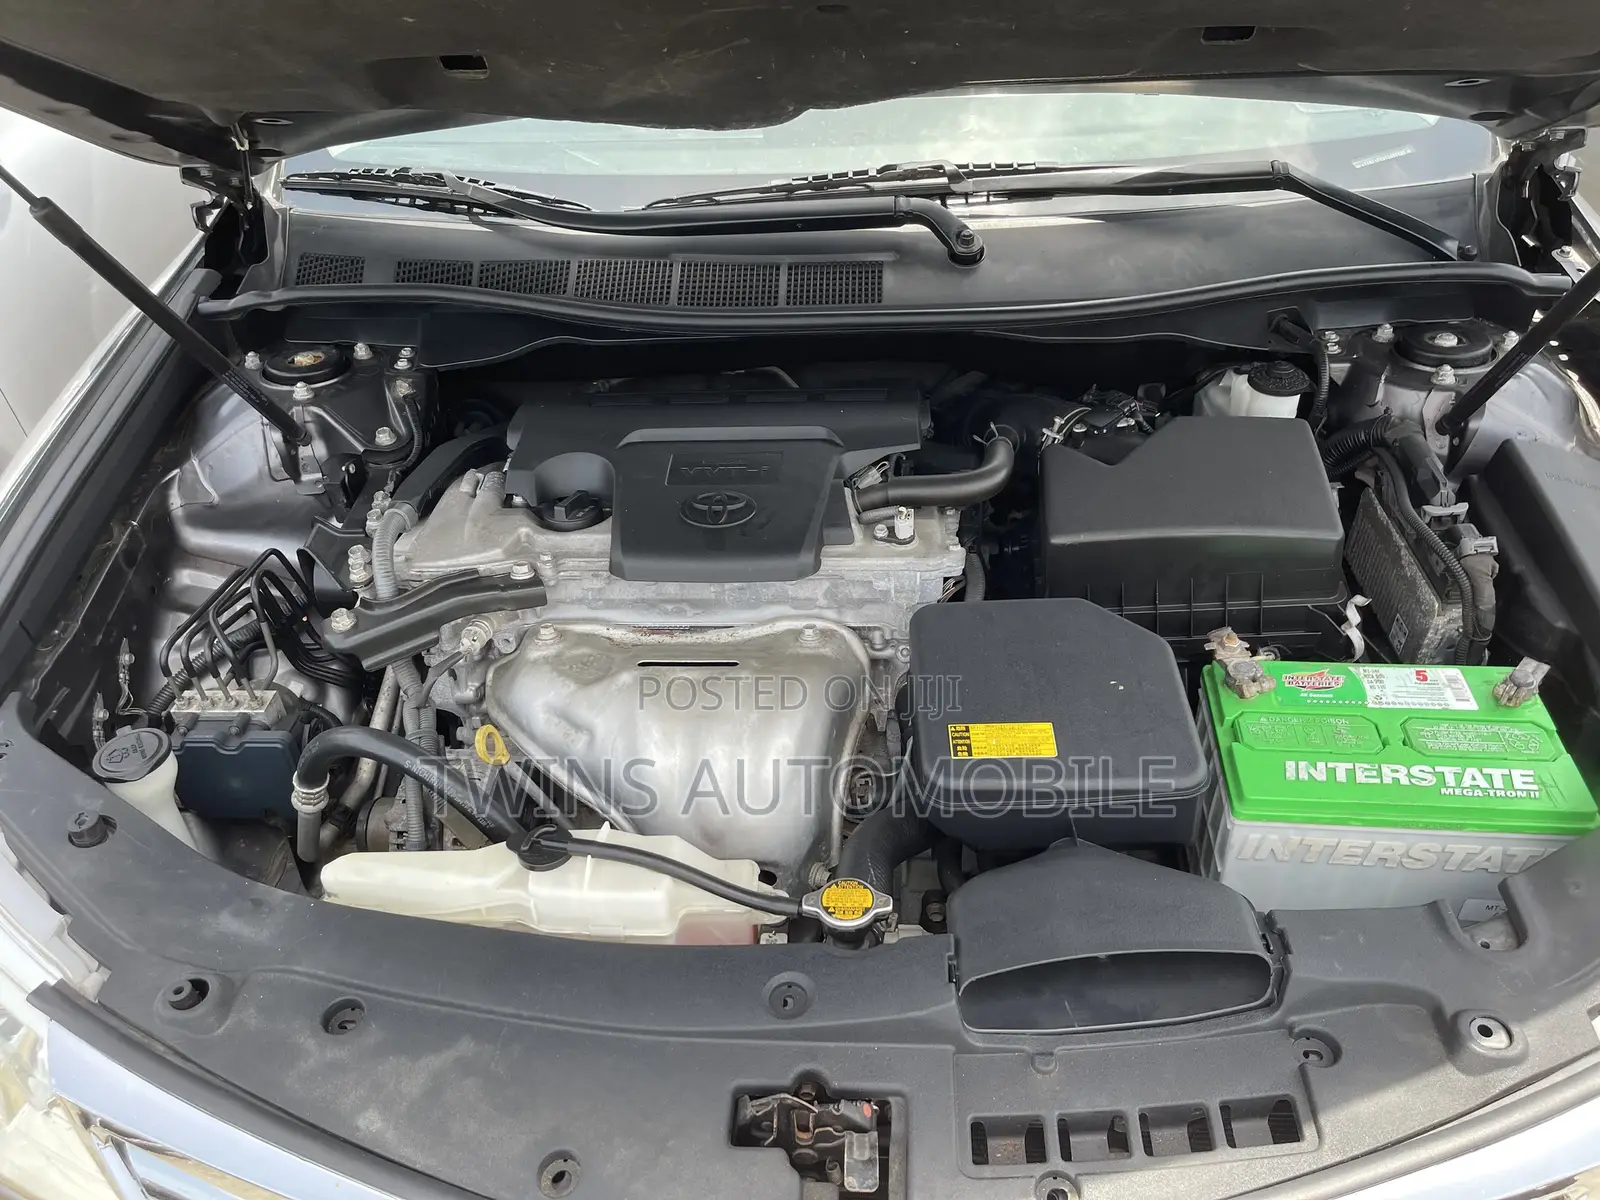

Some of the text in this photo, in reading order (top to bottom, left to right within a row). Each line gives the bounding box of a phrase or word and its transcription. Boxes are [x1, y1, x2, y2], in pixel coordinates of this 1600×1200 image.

[1284, 674, 1344, 682] INTERSTATE
[1415, 670, 1429, 682] 5
[1284, 759, 1540, 791] INTERSTATE
[1440, 787, 1528, 798] MEGA-TRON
[1237, 834, 1561, 875] INTERSTAT
